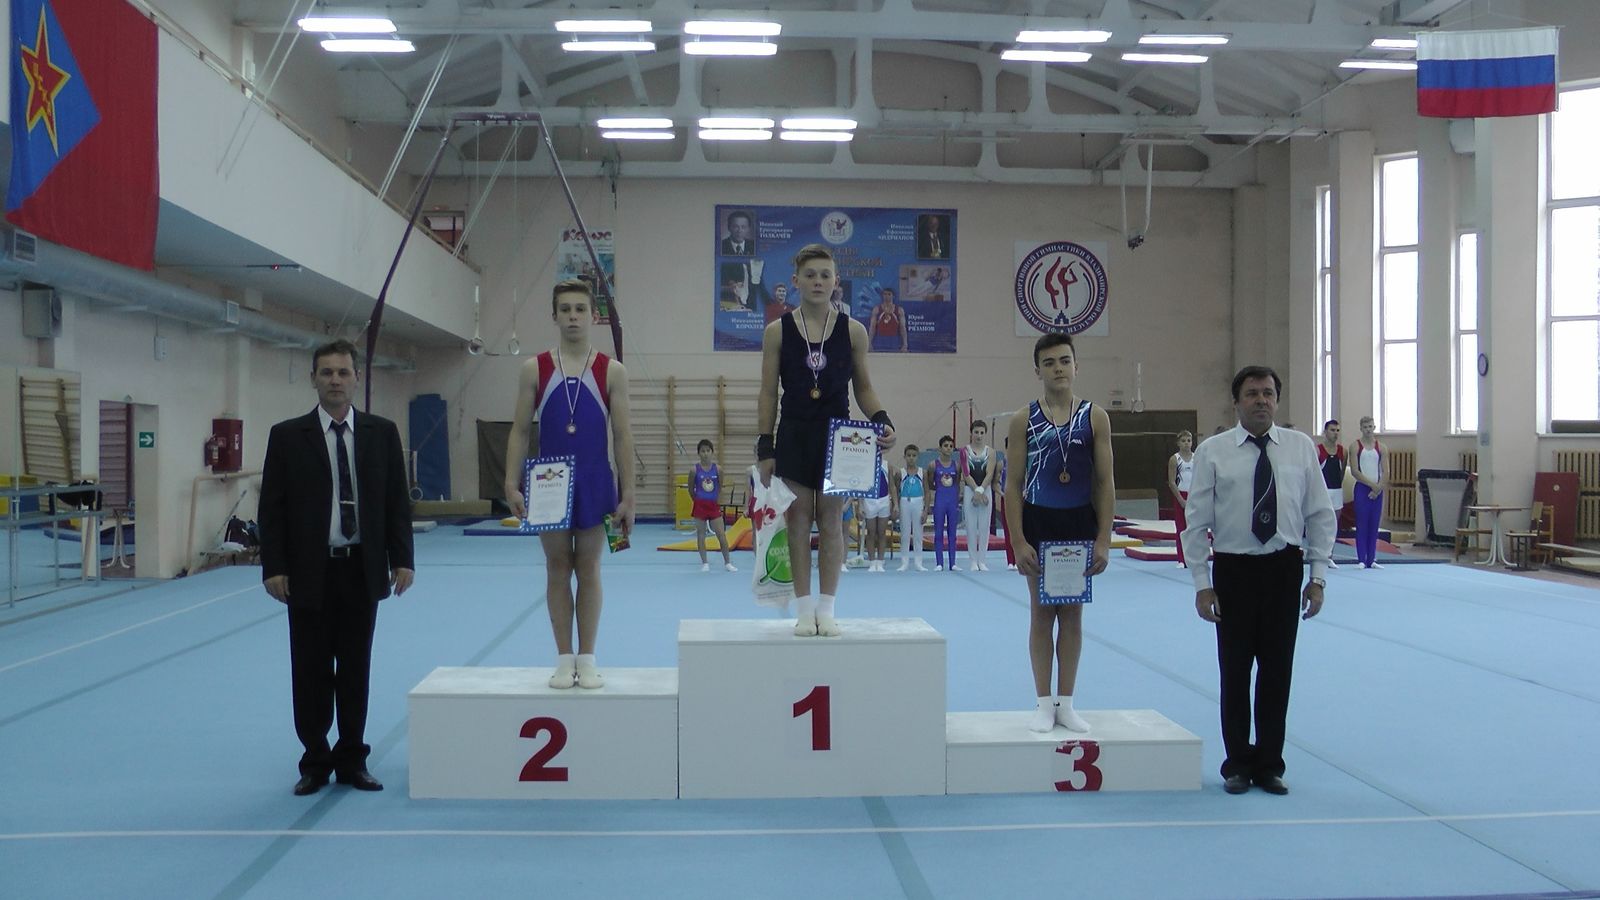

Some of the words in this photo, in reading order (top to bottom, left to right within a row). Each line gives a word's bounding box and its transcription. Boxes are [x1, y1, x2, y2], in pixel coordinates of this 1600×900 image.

[518, 716, 569, 782] 2
[793, 685, 831, 751] 1
[1054, 740, 1102, 792] 3
